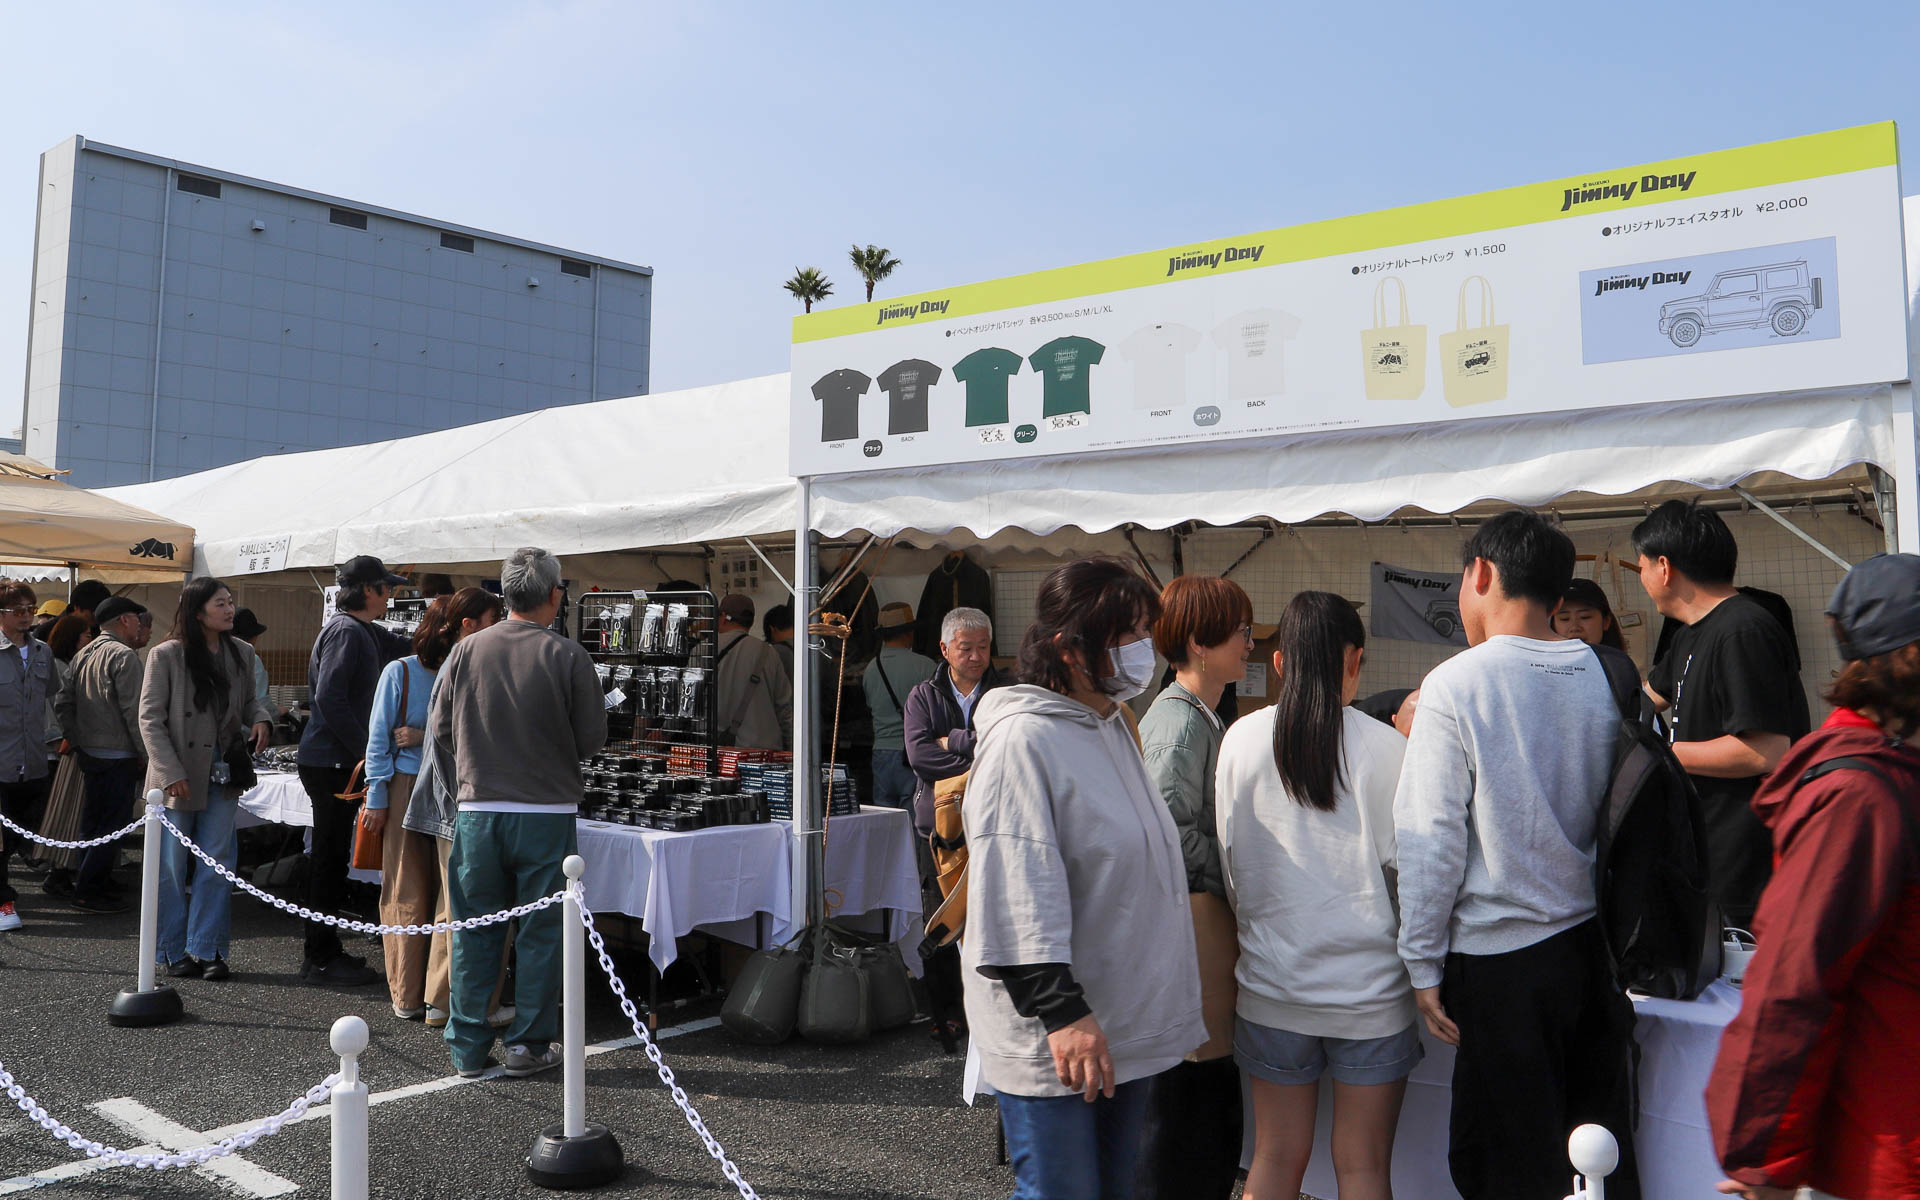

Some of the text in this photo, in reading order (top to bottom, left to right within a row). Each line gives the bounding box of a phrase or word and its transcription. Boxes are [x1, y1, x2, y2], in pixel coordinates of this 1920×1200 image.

[1561, 171, 1697, 212] Jimny Day
[1612, 196, 1808, 236] オリジナルフェイスタオル ¥2,000
[1167, 245, 1265, 277] Jimny Day
[1360, 243, 1506, 274] オリジナルトートバッグ ¥1,500
[1594, 270, 1692, 297] Jimny Day
[877, 299, 950, 325] Jimny Day
[1196, 412, 1218, 420] ホワイト
[1247, 400, 1266, 408] BACK
[1016, 430, 1036, 438] グリーン
[1422, 578, 1452, 592] Day
